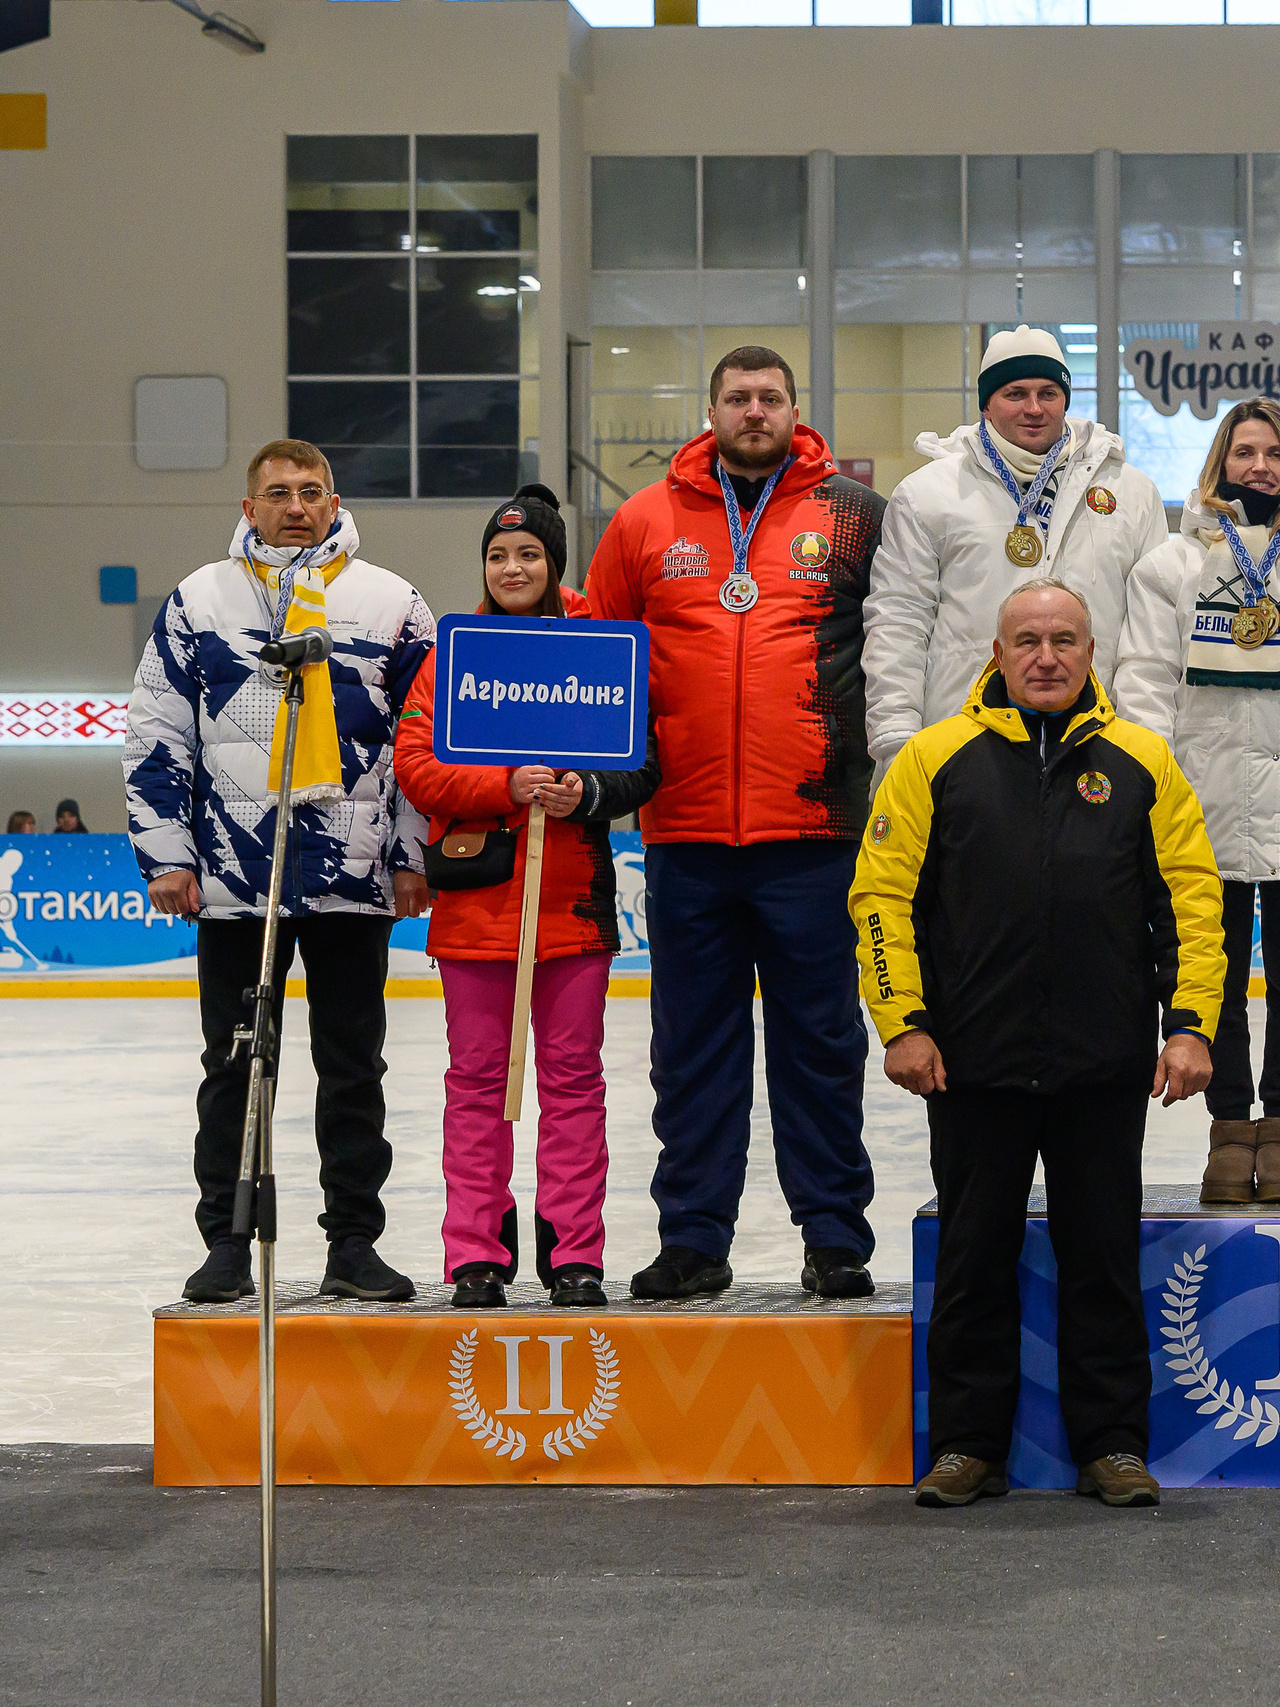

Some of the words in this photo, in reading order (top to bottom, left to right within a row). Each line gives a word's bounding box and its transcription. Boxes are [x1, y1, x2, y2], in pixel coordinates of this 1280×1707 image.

[1195, 615, 1233, 634] БЕЛЫ
[458, 672, 626, 710] Агрохолдинг
[867, 911, 896, 1001] BELARUS
[493, 1335, 574, 1415] II
